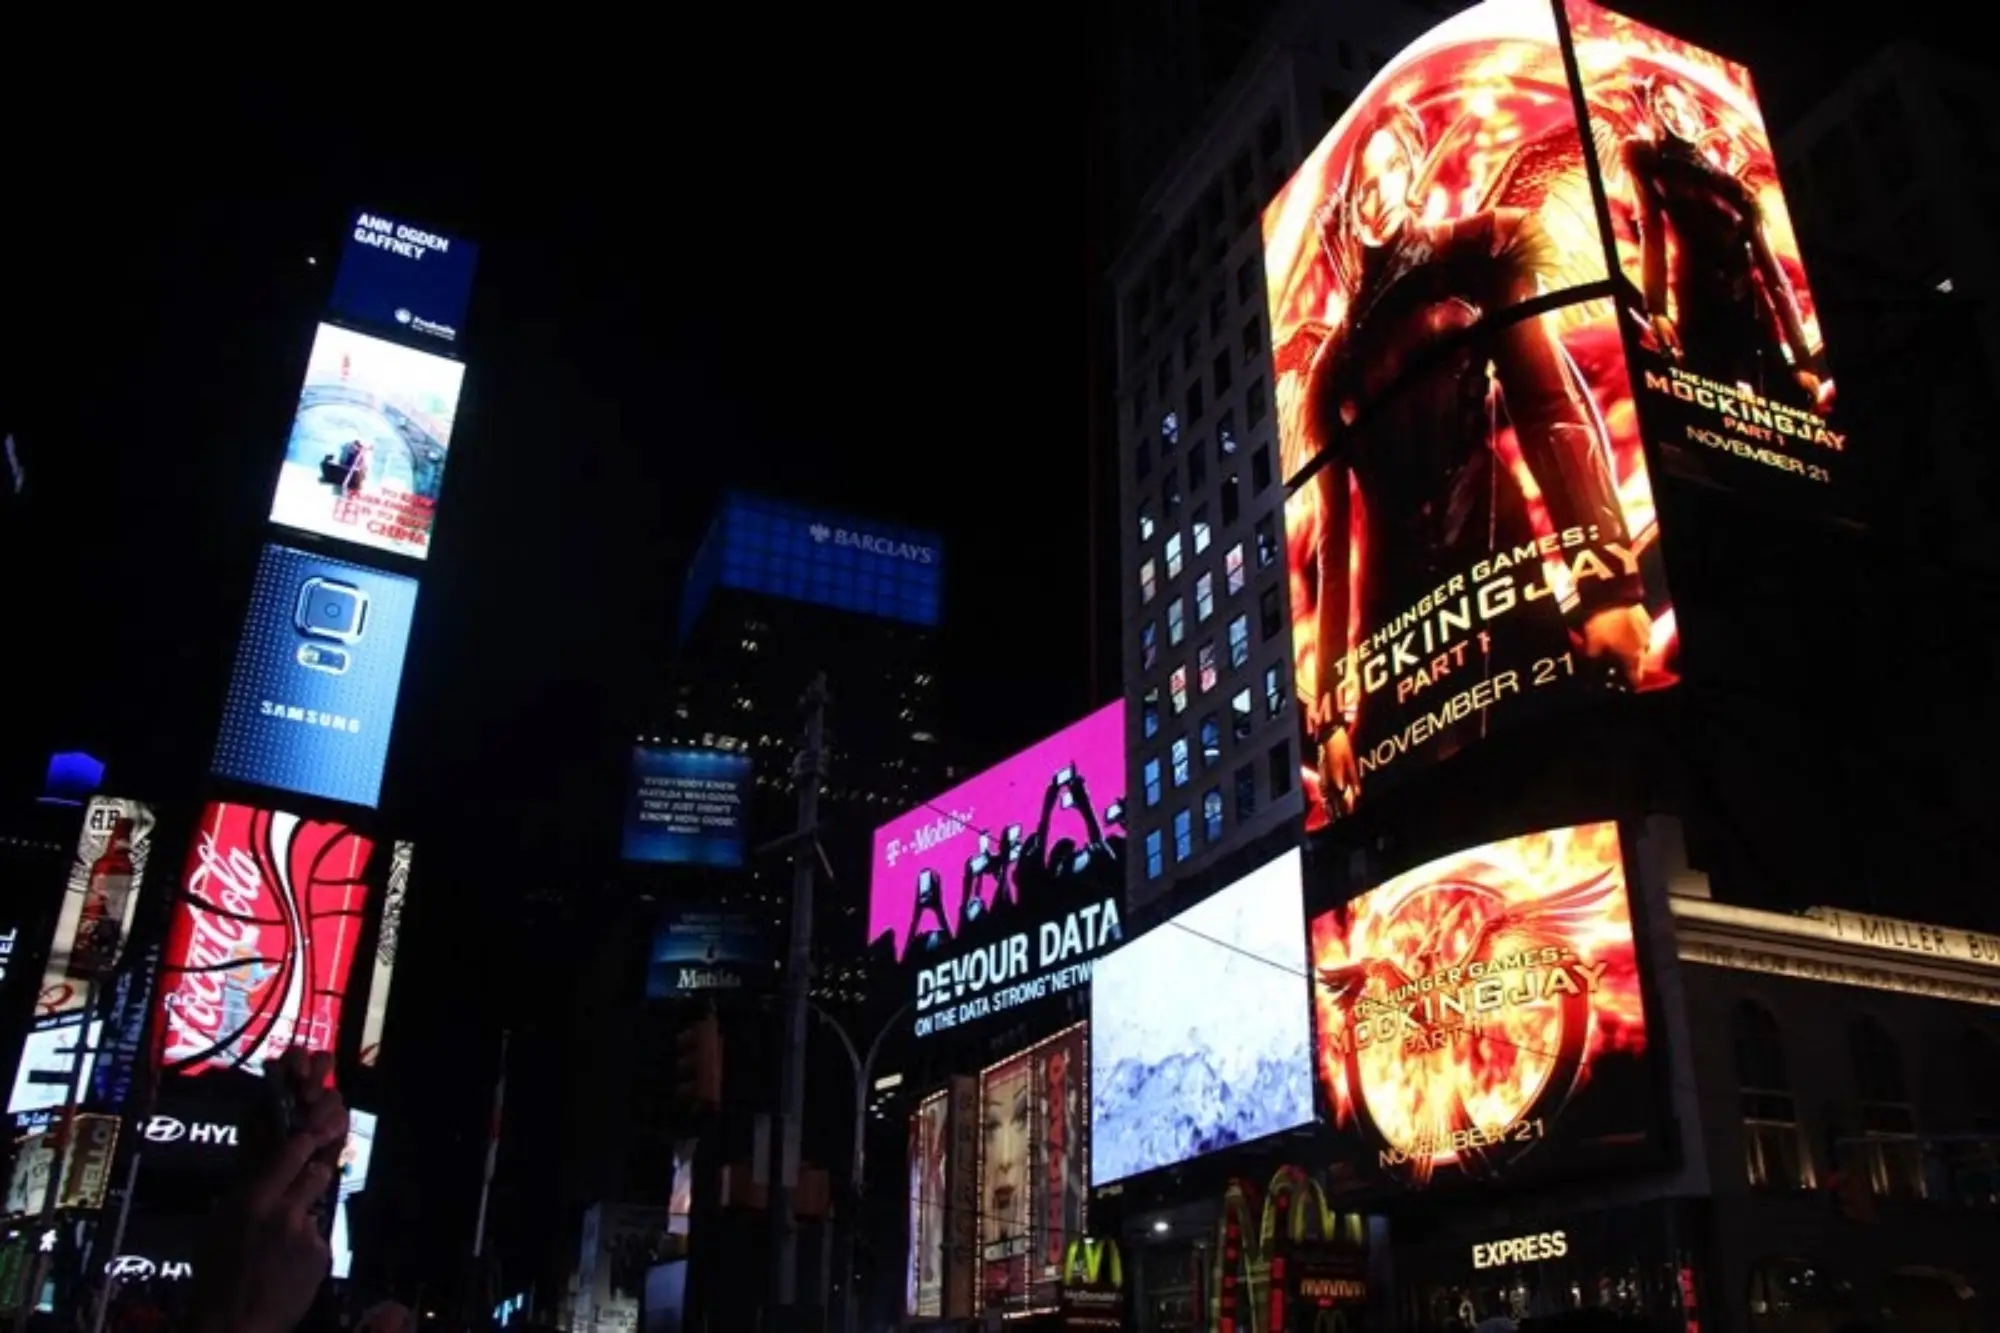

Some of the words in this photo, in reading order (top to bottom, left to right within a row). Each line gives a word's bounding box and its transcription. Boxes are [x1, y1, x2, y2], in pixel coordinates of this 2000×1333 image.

[353, 227, 426, 260] GAFFNEY
[357, 212, 393, 236] ANN
[397, 224, 450, 253] OGDEN
[1644, 369, 1846, 451] MOCKINGJAY
[1722, 416, 1774, 441] PART
[1686, 425, 1806, 476] NOVEMBER
[1806, 464, 1830, 484] 21
[834, 527, 933, 564] BARCLAYS
[1372, 573, 1466, 649] HUNGER
[1471, 524, 1600, 583] GAMES:
[1305, 522, 1659, 734] MOCKINGJAY
[1395, 640, 1470, 703] PART
[261, 700, 360, 734] SAMSUNG
[1359, 670, 1520, 777] NOVEMBER
[1532, 651, 1574, 686] 21
[917, 932, 1028, 1011] DEVOUR
[1040, 897, 1122, 967] DATA
[1859, 917, 1950, 954] MILLER
[914, 1016, 933, 1037] ON
[934, 1007, 957, 1032] THE
[959, 996, 990, 1024] DATA
[1514, 1118, 1544, 1141] 21
[1472, 1230, 1568, 1269] EXPRESS
